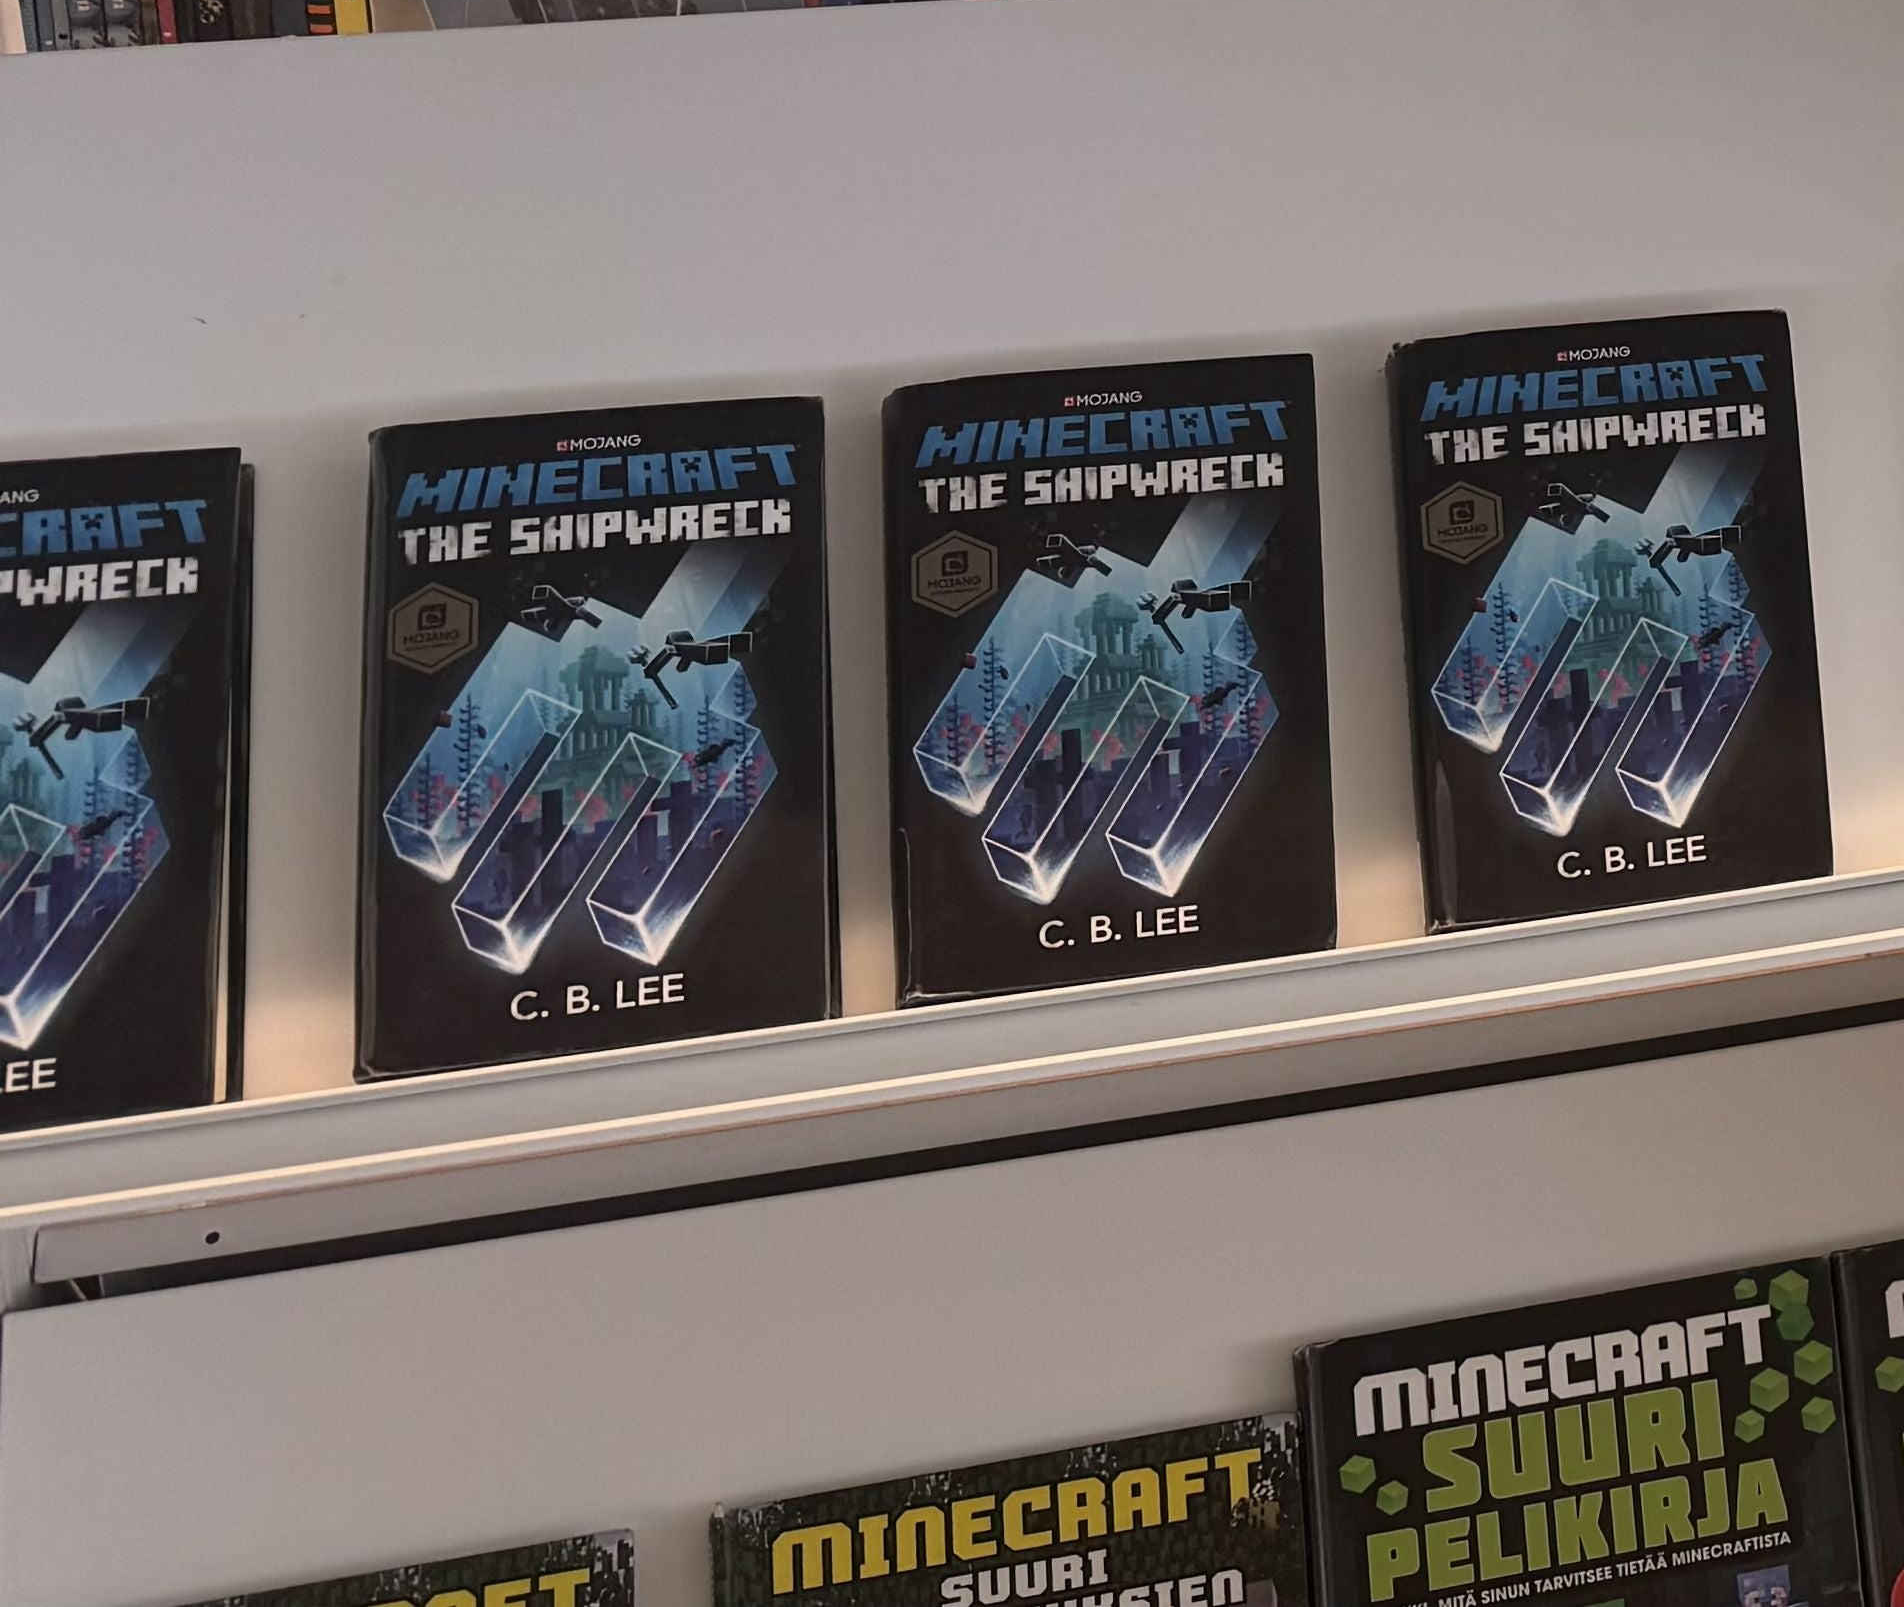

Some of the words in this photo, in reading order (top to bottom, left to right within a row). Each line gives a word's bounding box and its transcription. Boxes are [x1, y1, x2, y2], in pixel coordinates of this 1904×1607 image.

[1568, 345, 1632, 364] MOJANG
[1076, 390, 1144, 409] MOJANG
[1420, 354, 1767, 423] MINECRAFT
[569, 434, 642, 452] MOJANG
[914, 400, 1290, 469] MINECRAFT
[1424, 427, 1508, 465] THE
[1522, 403, 1767, 457] SHIPWRECK
[395, 443, 798, 519] MINECRAFT
[917, 474, 1008, 515] THE
[1022, 451, 1286, 507] SHIPWRECK
[399, 522, 494, 566] THE
[509, 497, 792, 557] SHIPWRECK
[1556, 850, 1591, 880] C.
[1605, 844, 1636, 875] B.
[1646, 834, 1708, 870] LEE
[1038, 919, 1077, 951] C.
[1089, 913, 1123, 945] B.
[1135, 903, 1200, 941] LEE
[509, 990, 550, 1023] C.
[565, 986, 600, 1015] B.
[615, 972, 685, 1011] LEE
[1353, 1304, 1772, 1437] MINECRAFT
[1422, 1378, 1725, 1514] SUURI
[771, 1448, 1262, 1595] MINECRAFT
[1366, 1457, 1789, 1603] PELIKIRJA
[1480, 1583, 1531, 1605] SINUN
[1534, 1564, 1614, 1595] TARVITSEE
[1616, 1552, 1669, 1578] TIETÄÄ
